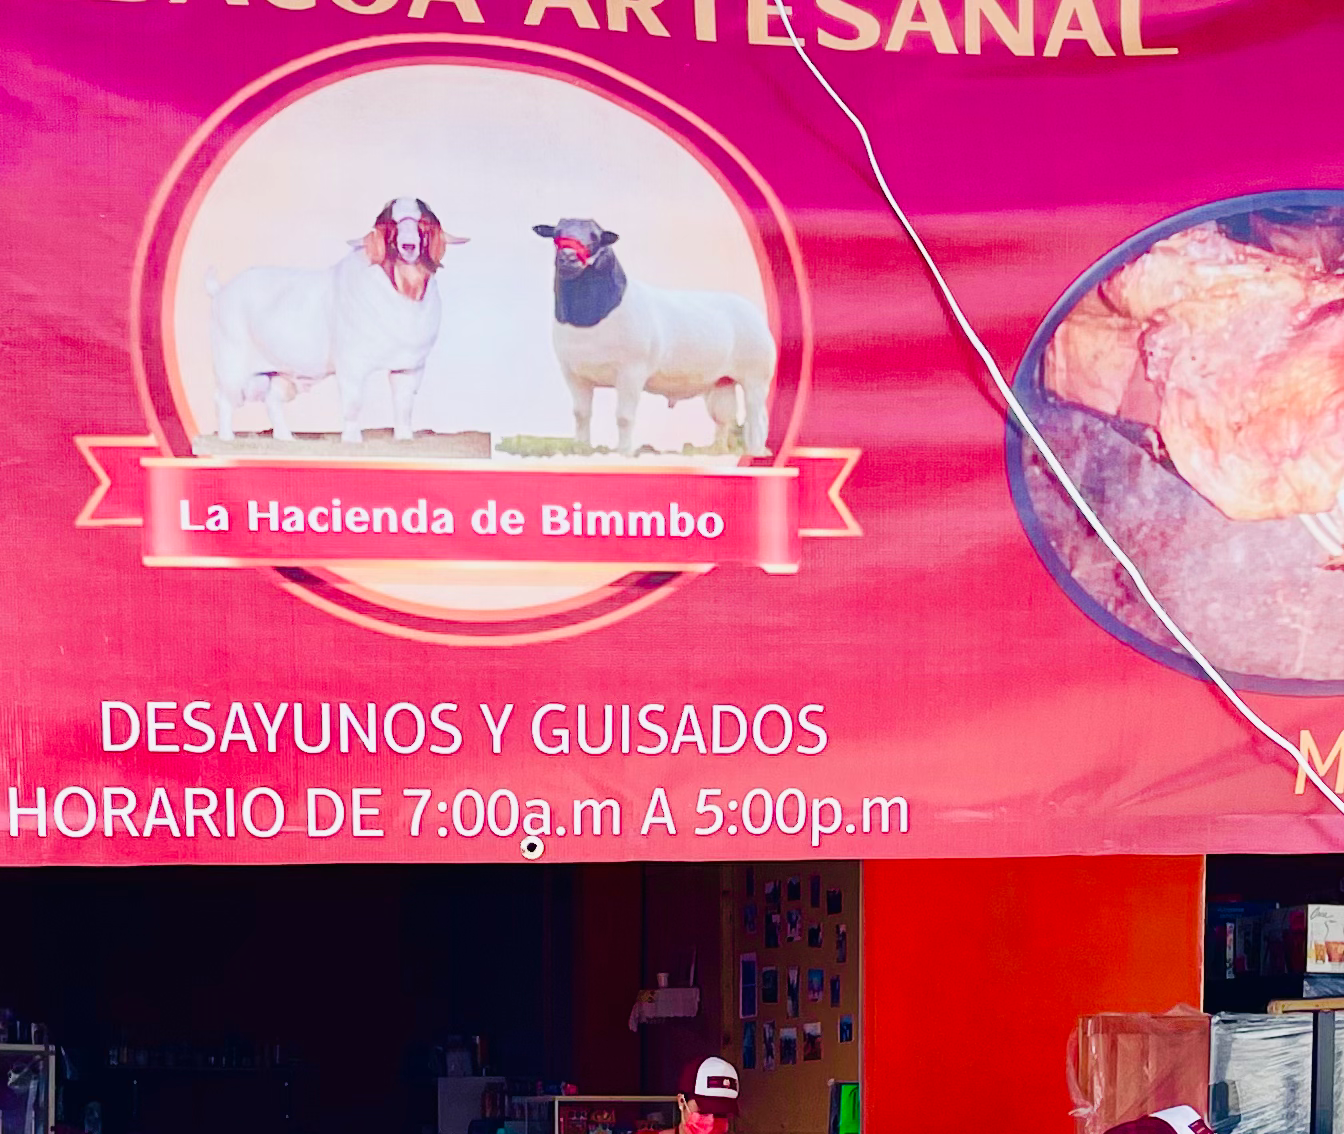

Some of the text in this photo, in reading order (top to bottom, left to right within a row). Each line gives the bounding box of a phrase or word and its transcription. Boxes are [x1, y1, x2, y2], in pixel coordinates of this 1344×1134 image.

[178, 497, 725, 539] La Hacienda de Bimmbo
[100, 700, 829, 756] DESAYUNOS Y GUISADOS
[8, 786, 909, 847] HORARIO DE 7:00a.m A 5:00p.m
